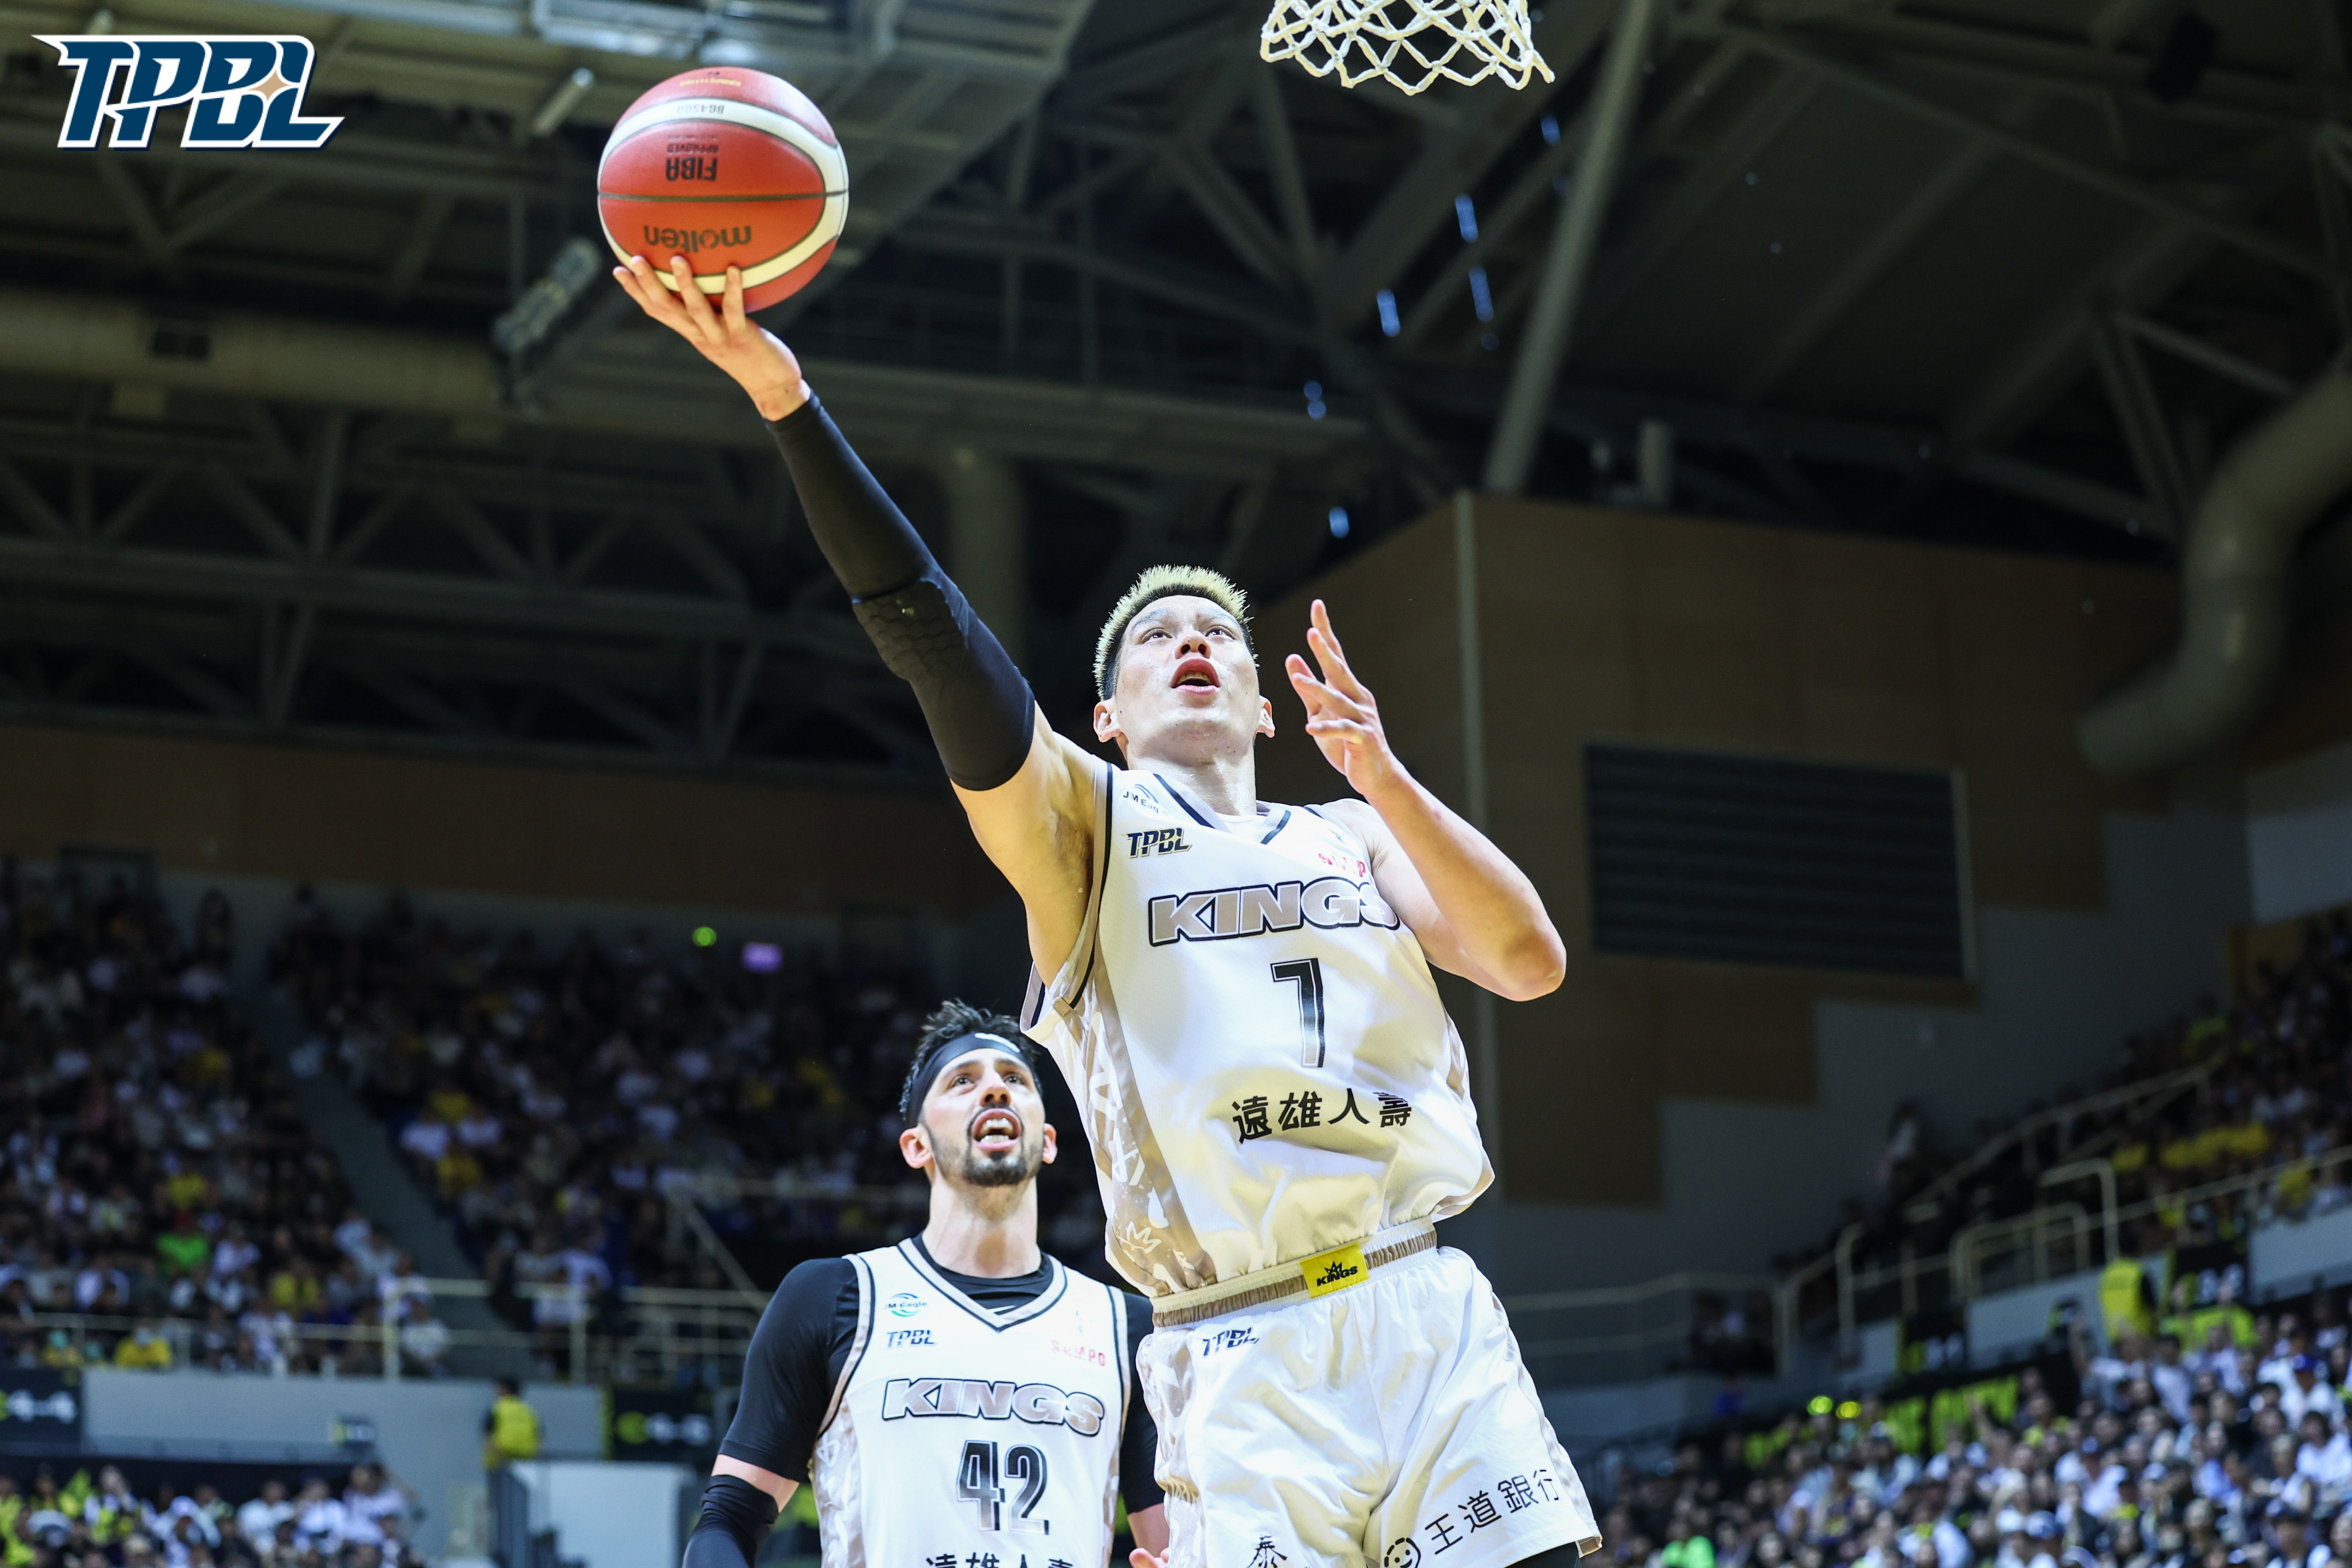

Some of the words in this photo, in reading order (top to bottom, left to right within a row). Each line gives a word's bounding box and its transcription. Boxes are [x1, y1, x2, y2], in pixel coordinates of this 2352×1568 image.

[666, 157, 717, 181] FIBA
[644, 225, 751, 253] molten
[1122, 828, 1192, 858] TPBL
[1149, 876, 1400, 946] KINGS
[1271, 958, 1325, 1068] 7
[1232, 1087, 1412, 1144] 遠雄人壽
[1316, 1266, 1358, 1287] KINGS
[887, 1330, 938, 1349] TPBL
[1200, 1327, 1259, 1358] TPBL
[882, 1378, 1105, 1437] KINGS
[956, 1440, 1049, 1535] 42
[1424, 1469, 1559, 1555] 王道銀行
